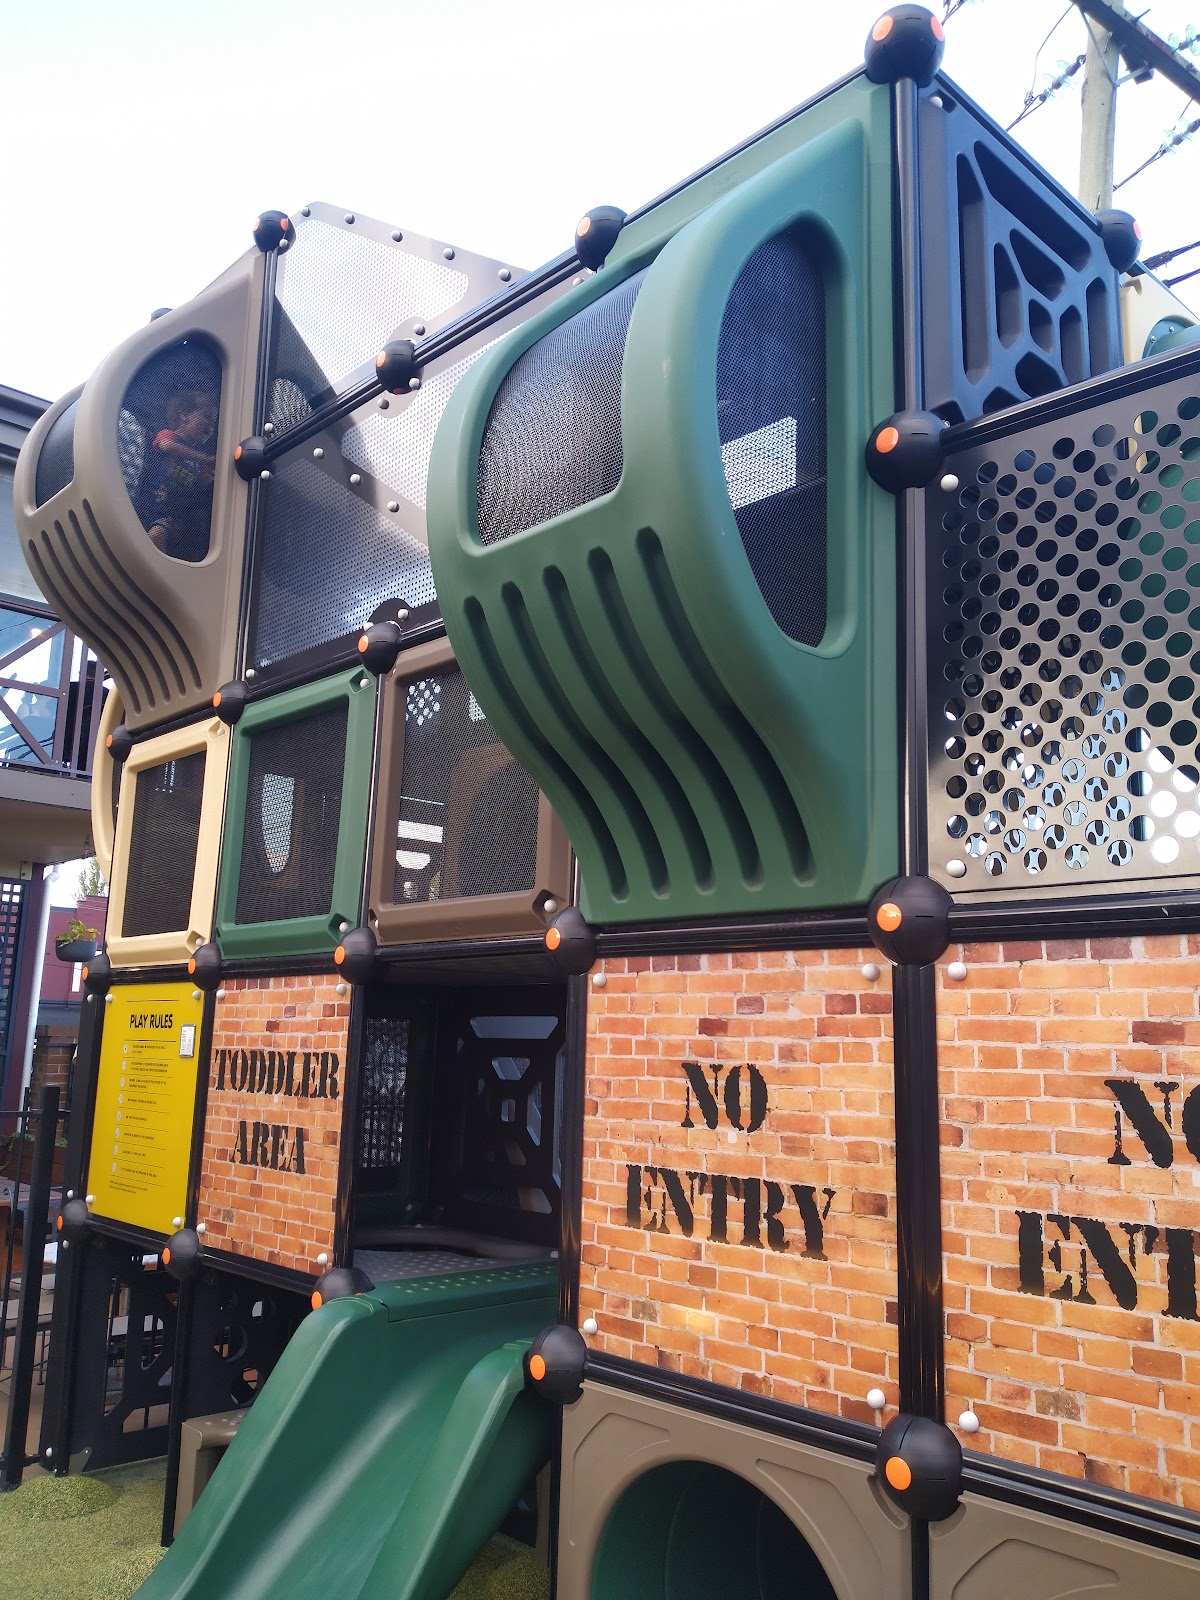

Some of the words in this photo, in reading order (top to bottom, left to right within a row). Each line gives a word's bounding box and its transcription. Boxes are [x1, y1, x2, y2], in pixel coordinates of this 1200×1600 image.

[130, 1014, 148, 1028] PLAY
[150, 1014, 173, 1028] RULES
[214, 1050, 340, 1100] TODDLER
[681, 1063, 768, 1133] NO
[229, 1121, 307, 1174] AREA
[1104, 1080, 1200, 1168] N
[625, 1164, 836, 1261] ENTRY
